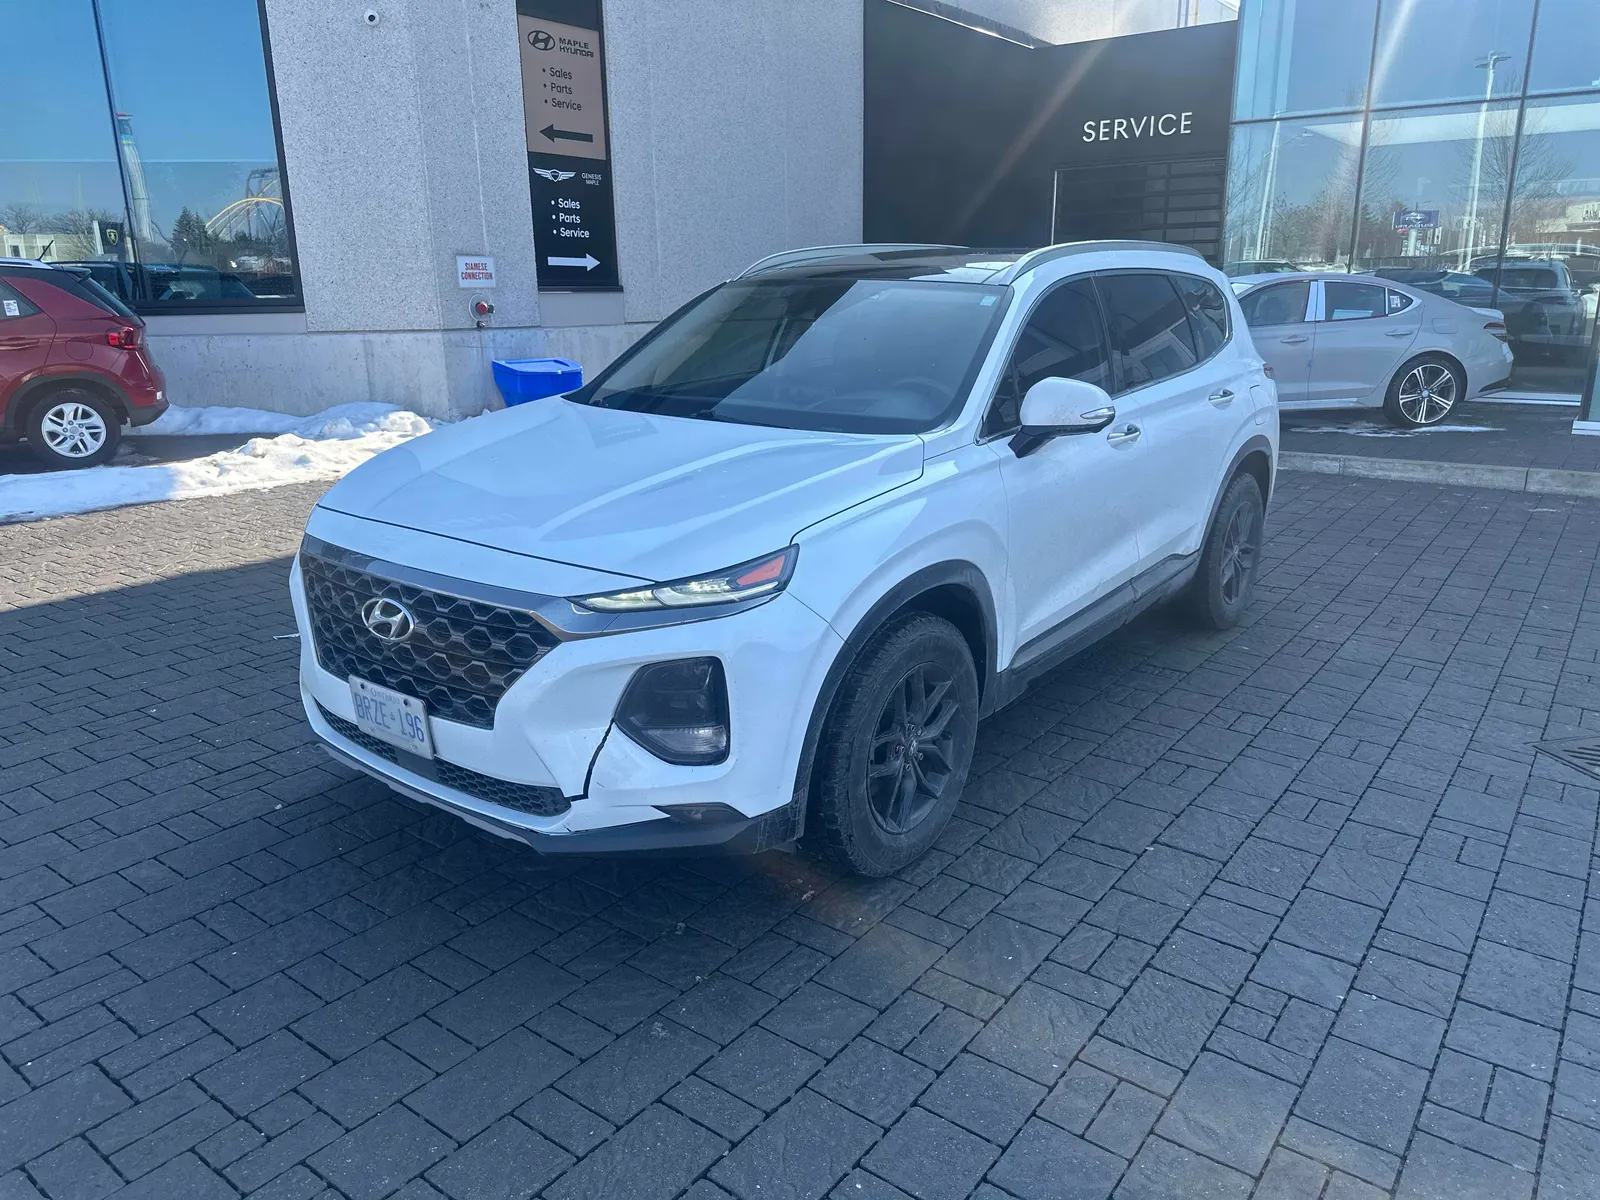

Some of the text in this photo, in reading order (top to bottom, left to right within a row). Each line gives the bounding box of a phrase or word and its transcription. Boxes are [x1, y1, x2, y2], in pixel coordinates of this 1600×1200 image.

[559, 37, 589, 49] MAPLE
[559, 45, 595, 58] HYUNDAI
[549, 67, 573, 80] Sales
[550, 82, 573, 95] Parts
[551, 98, 582, 111] Service
[1082, 112, 1193, 142] SERVICE
[581, 172, 602, 181] GENESIS
[558, 198, 581, 209] Sales
[559, 213, 581, 224] Parts
[560, 227, 590, 238] Service
[464, 262, 488, 271] SIAMESE
[460, 271, 493, 280] CONNECTION
